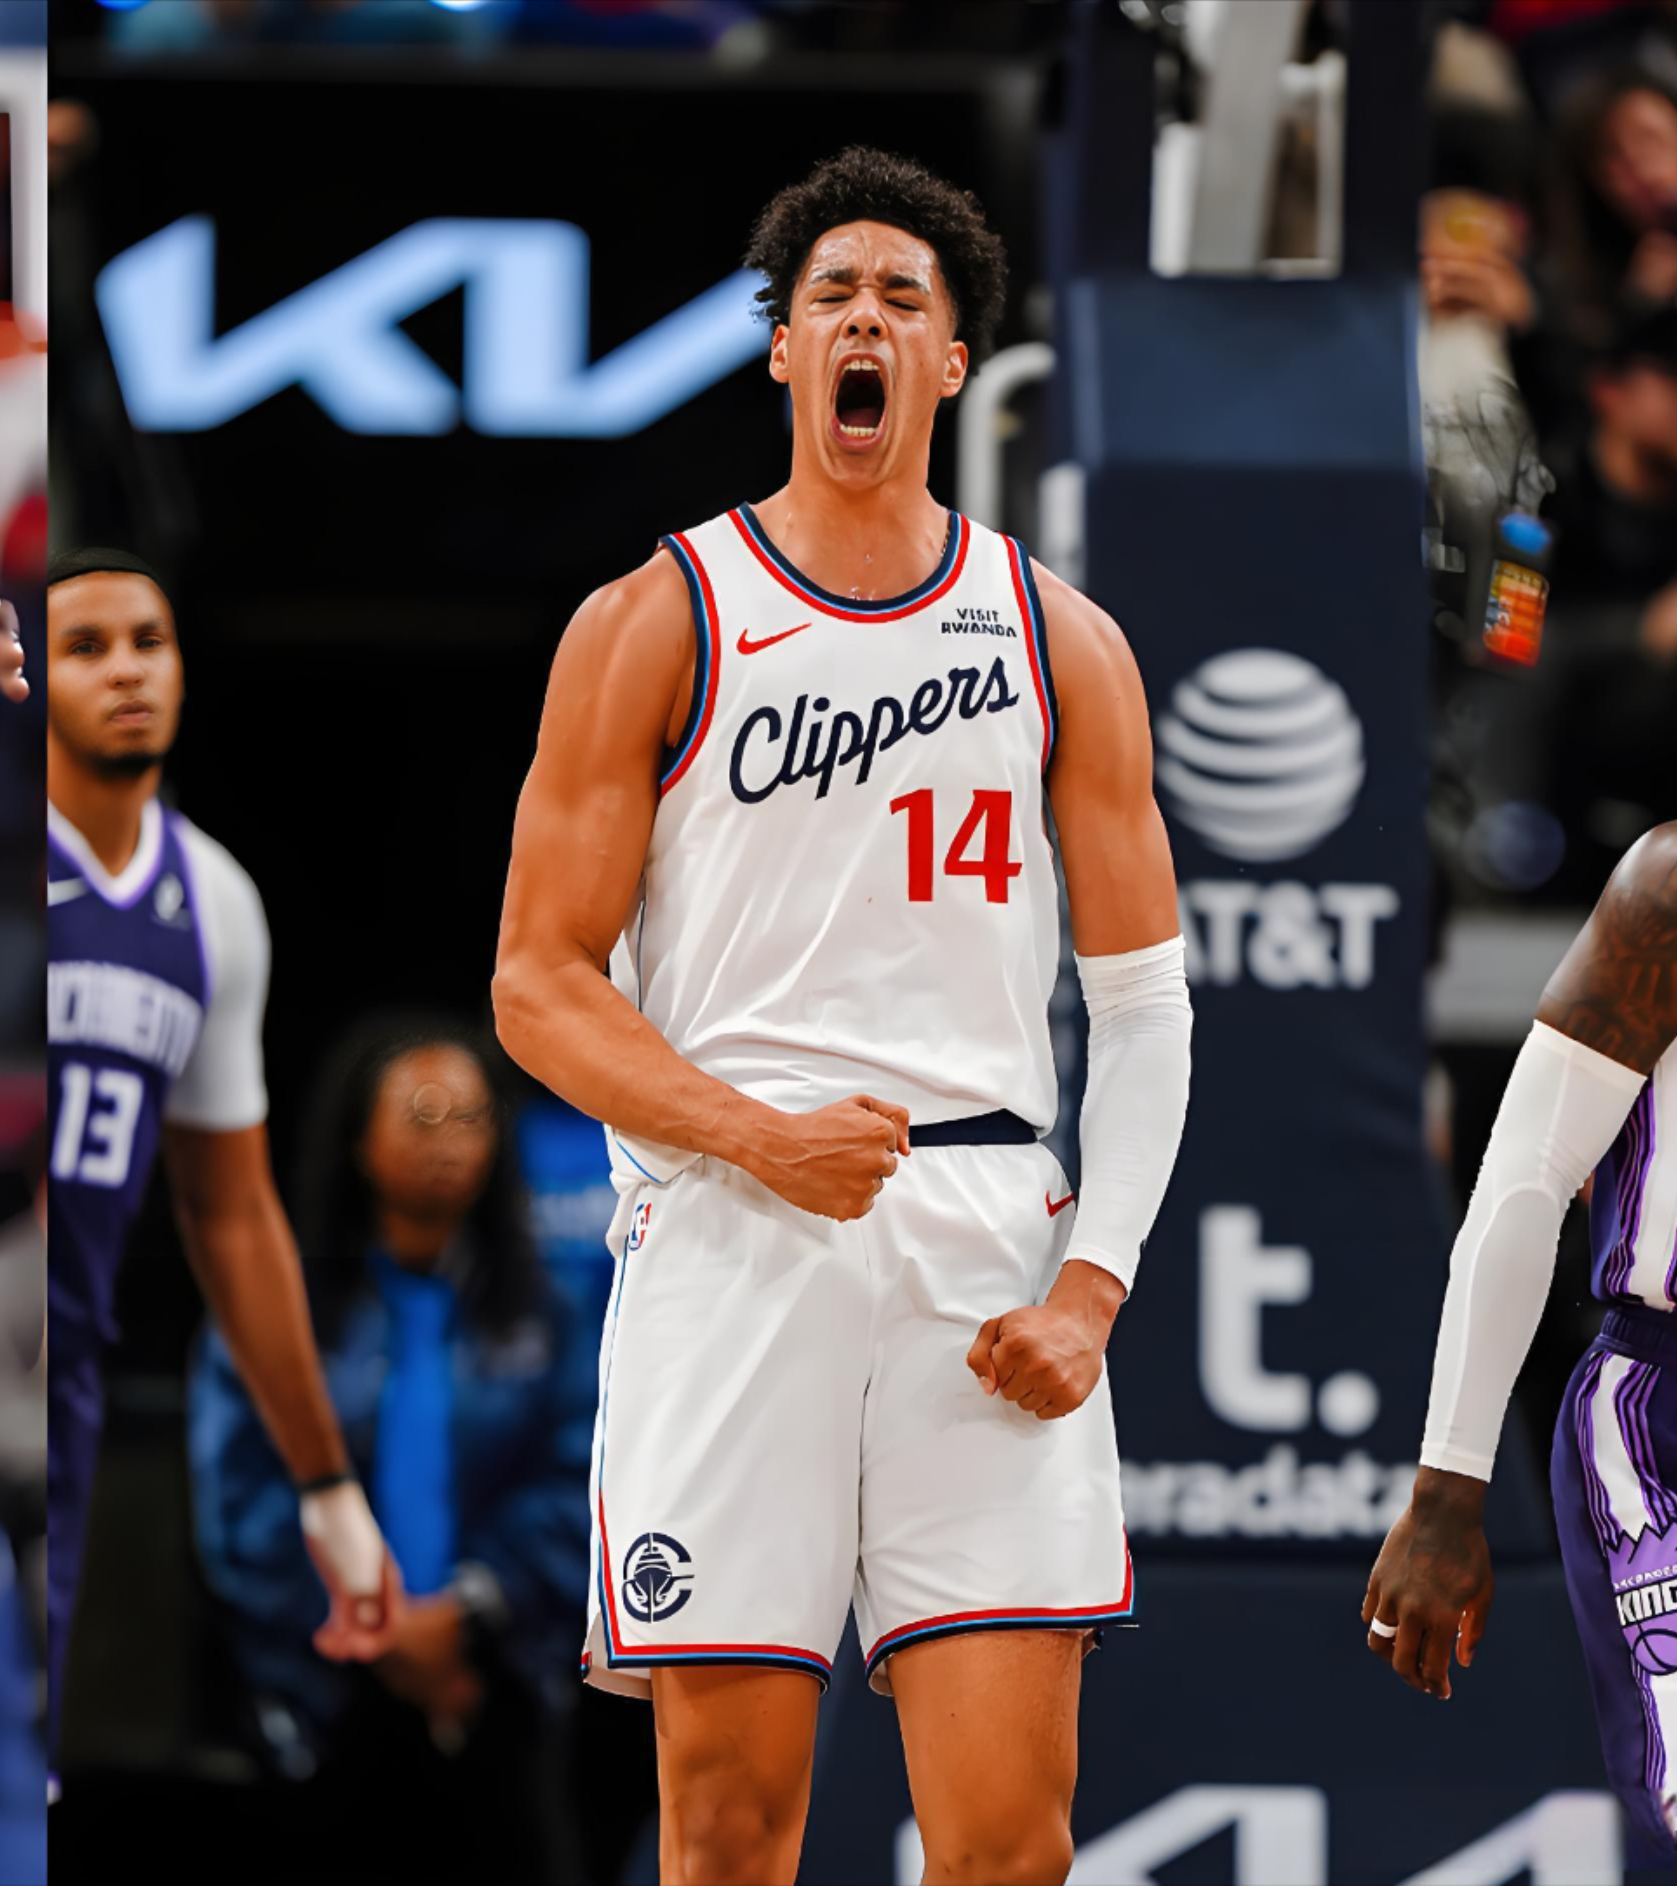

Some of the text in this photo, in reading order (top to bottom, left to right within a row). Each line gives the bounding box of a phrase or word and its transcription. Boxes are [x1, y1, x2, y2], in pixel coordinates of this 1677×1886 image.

[940, 622, 1017, 638] RWANDA
[956, 608, 999, 622] VISIT
[729, 656, 1020, 804] Clippers
[889, 788, 1023, 904] 14
[51, 1062, 144, 1188] 13
